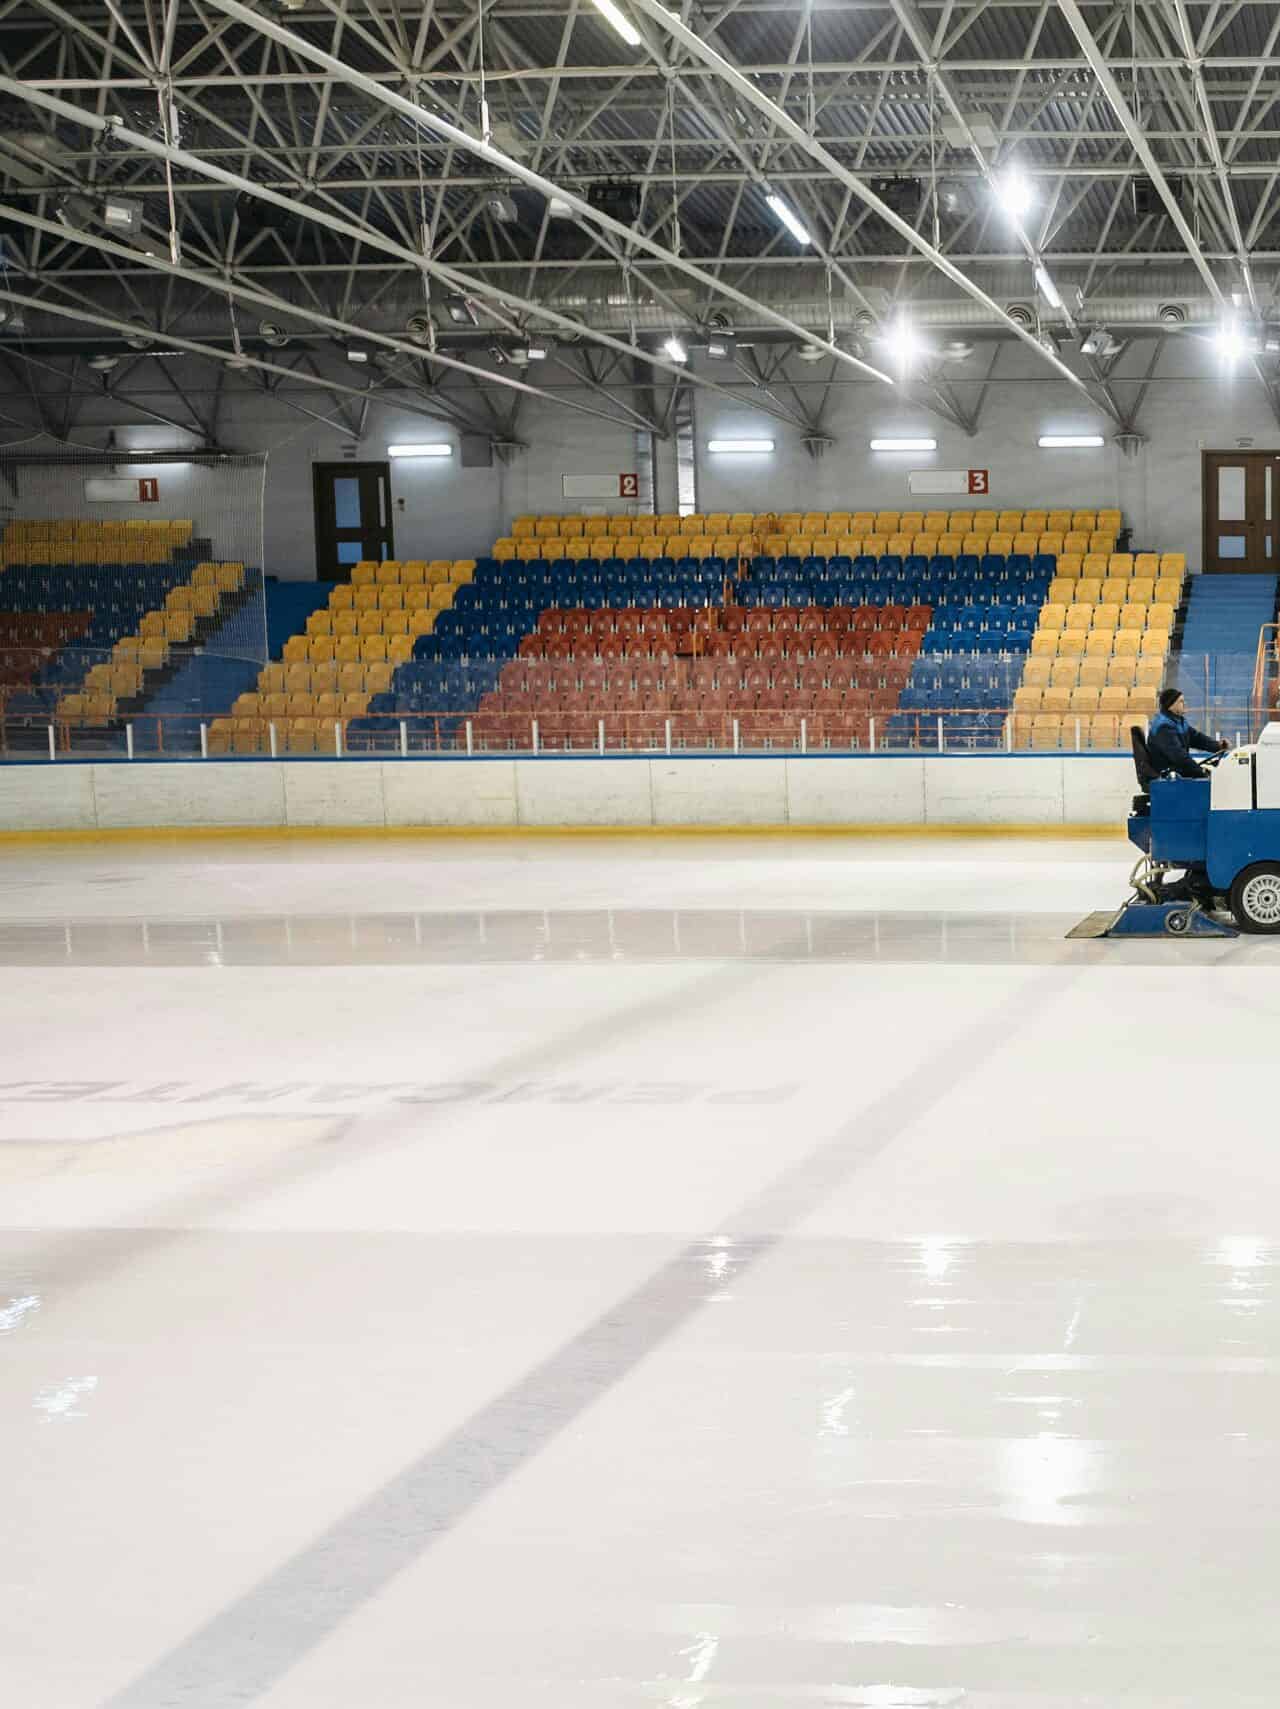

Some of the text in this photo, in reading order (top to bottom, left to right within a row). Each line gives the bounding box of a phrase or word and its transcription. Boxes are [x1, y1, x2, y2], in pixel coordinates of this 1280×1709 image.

[144, 480, 152, 499] 1
[624, 476, 636, 494] 2
[973, 473, 985, 491] 3
